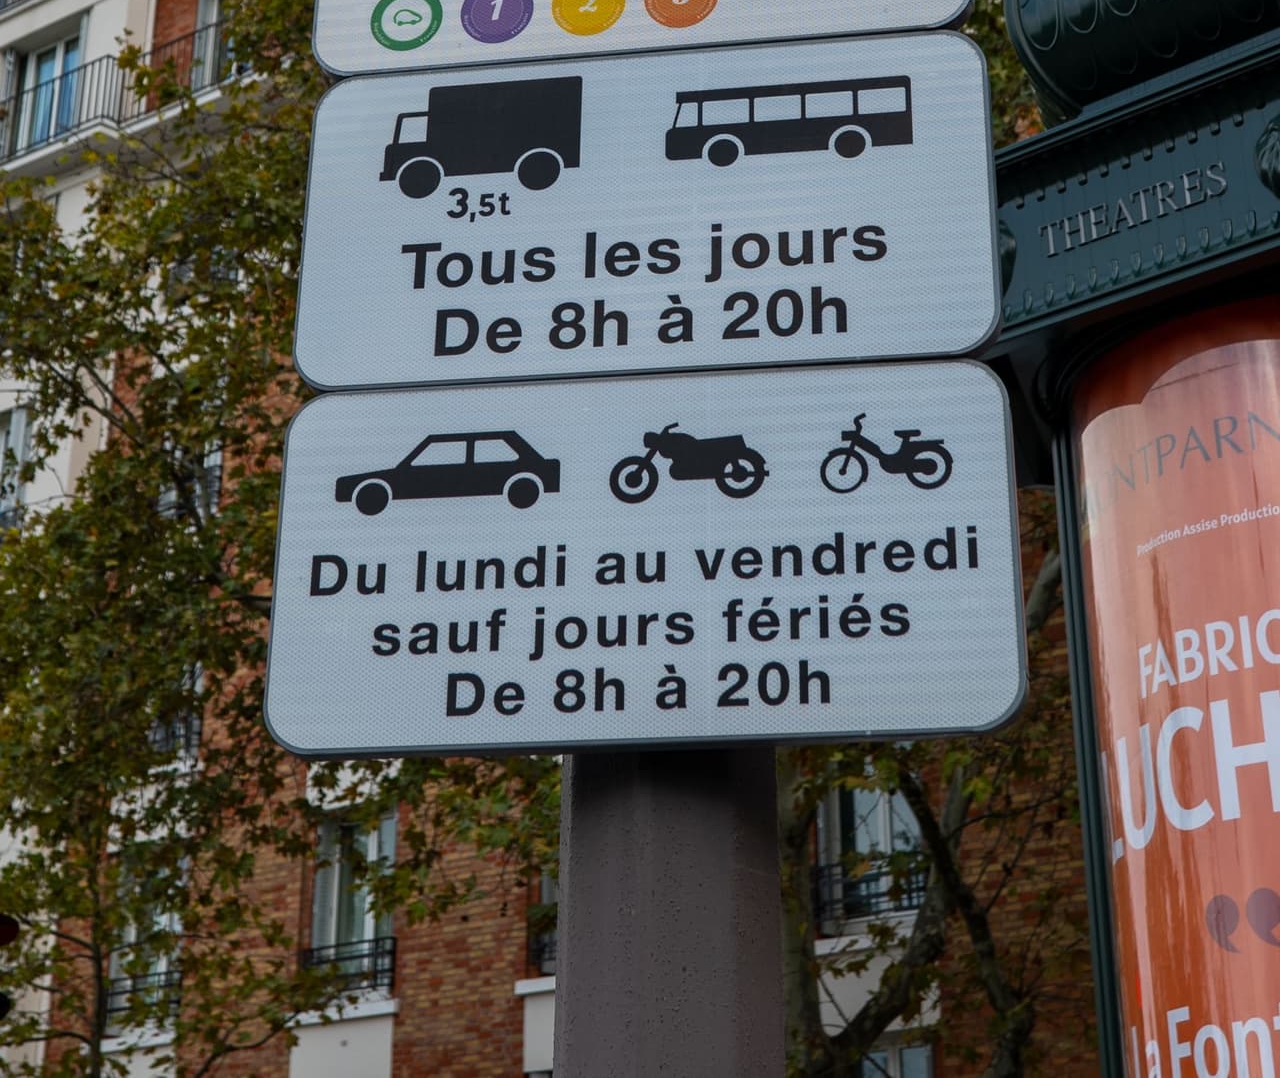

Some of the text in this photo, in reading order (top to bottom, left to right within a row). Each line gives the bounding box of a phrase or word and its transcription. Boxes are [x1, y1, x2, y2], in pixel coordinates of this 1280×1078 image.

[445, 186, 512, 223] 3,5t
[1038, 162, 1228, 258] THEATRES
[401, 223, 888, 290] Tous les jours
[433, 286, 848, 357] De 8h à 20h
[309, 525, 980, 597] Du lundi au vendredi
[1136, 529, 1181, 557] Production
[1183, 518, 1218, 537] Assise
[371, 592, 912, 662] sauf jours fériés
[445, 659, 831, 718] De 8h à 20h
